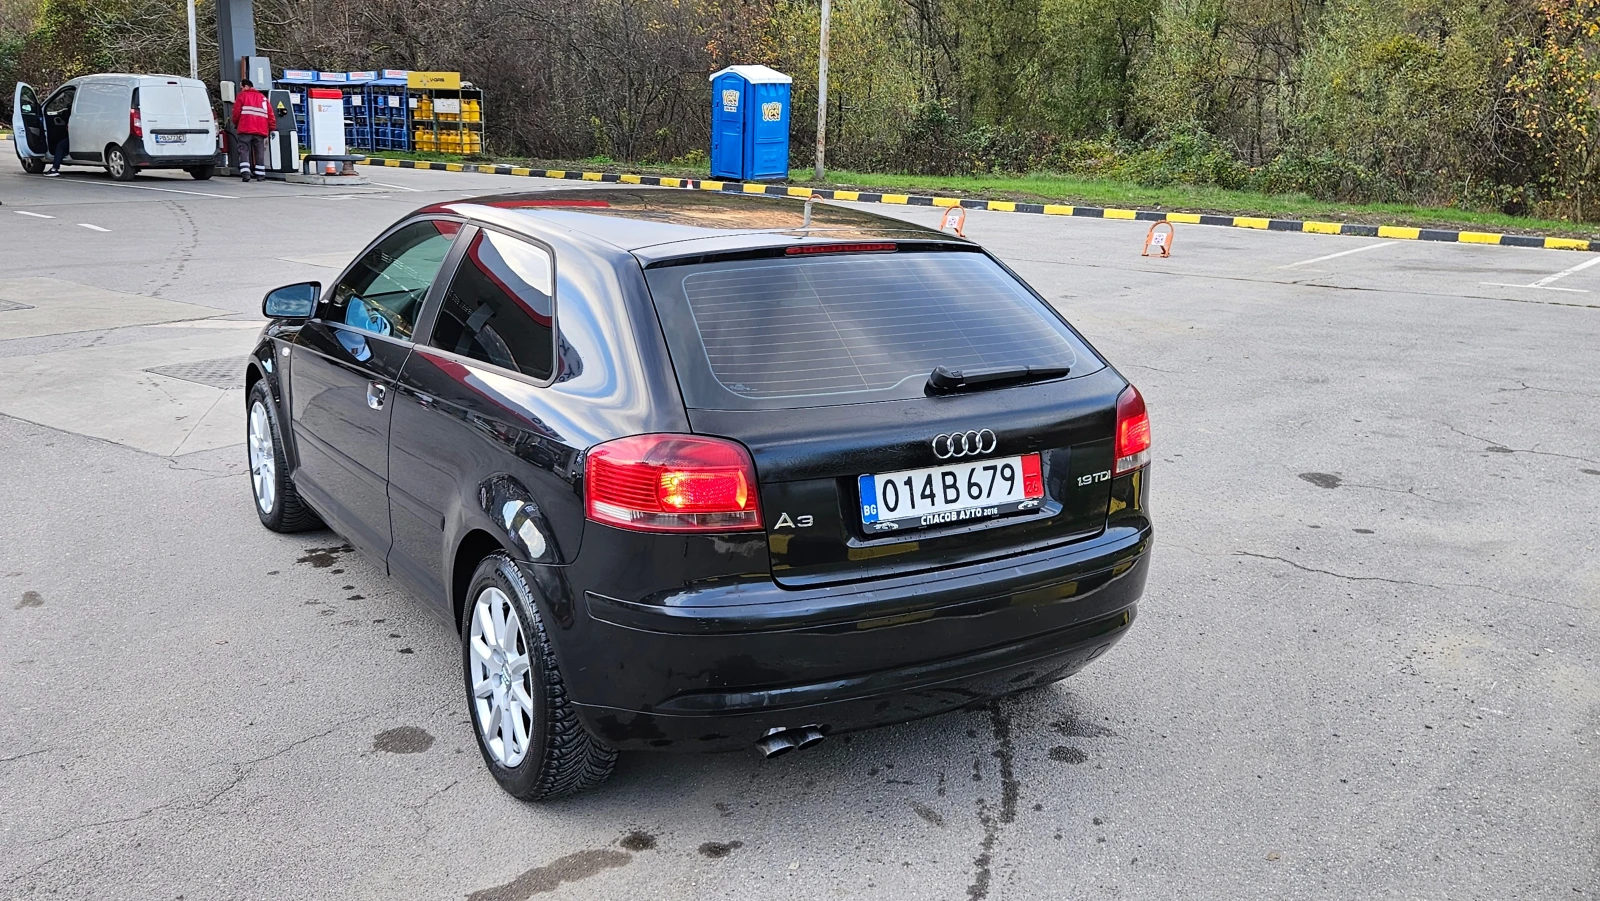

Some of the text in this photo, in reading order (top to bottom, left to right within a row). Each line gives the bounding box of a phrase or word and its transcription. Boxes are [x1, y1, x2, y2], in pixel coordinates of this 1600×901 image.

[1092, 470, 1111, 483] TDI
[1026, 481, 1040, 493] 26
[864, 504, 877, 516] BG
[921, 507, 998, 525] СПАСОВ АУТО 2016
[774, 512, 814, 529] A3
